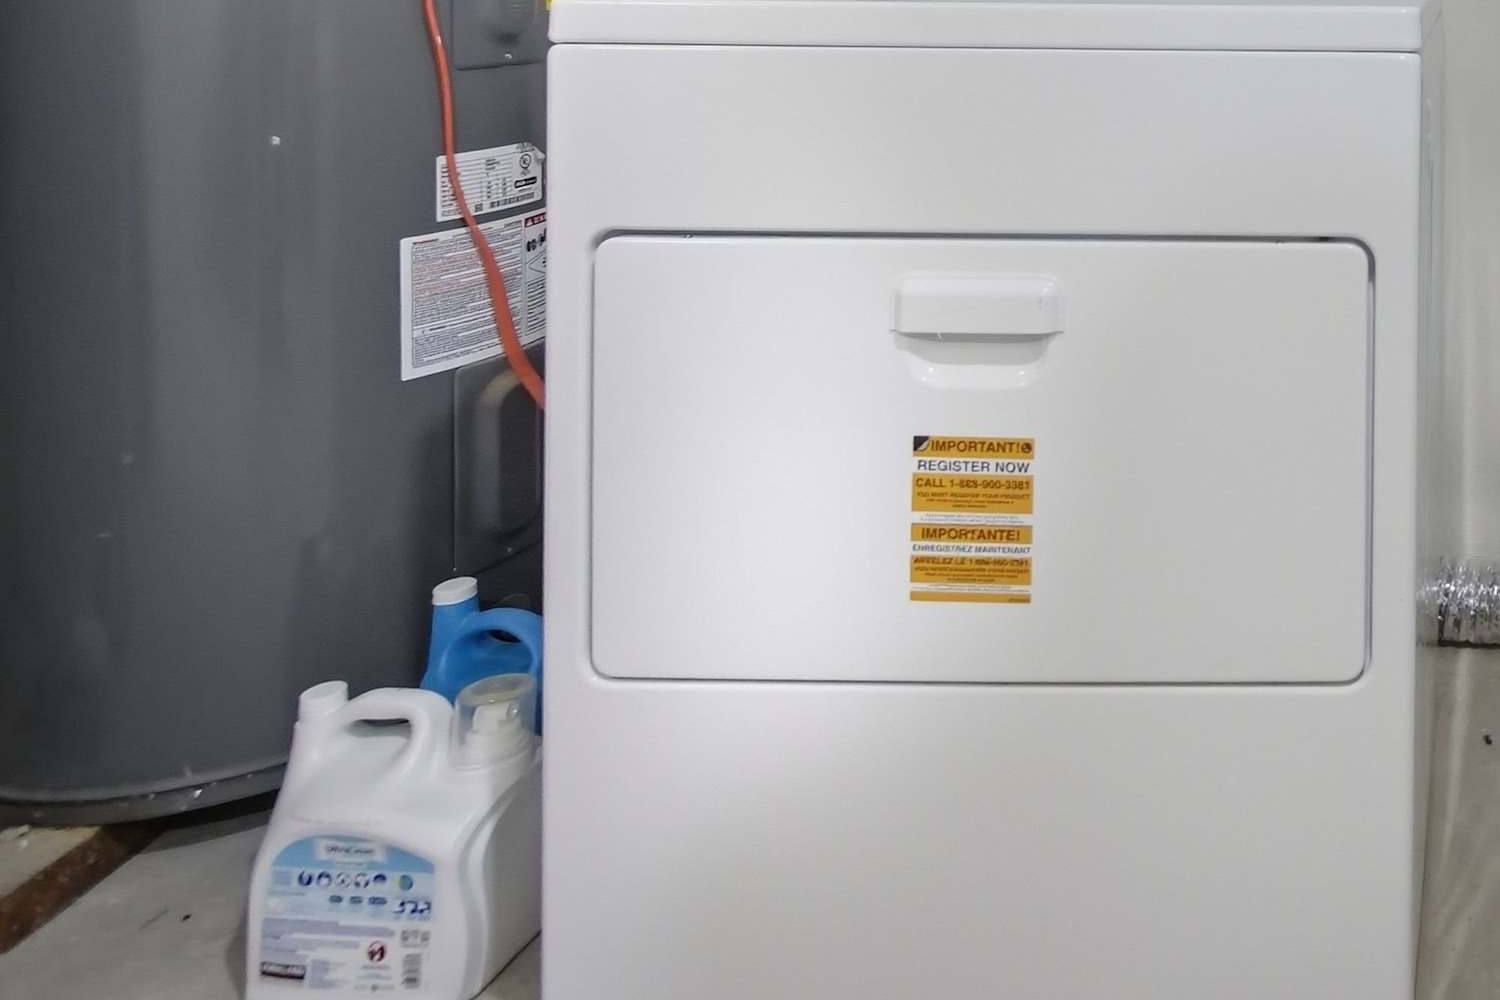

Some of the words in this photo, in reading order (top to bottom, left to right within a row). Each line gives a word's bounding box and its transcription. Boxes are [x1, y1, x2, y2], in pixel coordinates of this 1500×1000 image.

[931, 440, 1020, 454] IMPORTANT!
[917, 460, 990, 472] REGISTER
[995, 462, 1030, 473] NOW
[915, 478, 946, 488] CALL
[921, 527, 1020, 541] IMPORTANTE!
